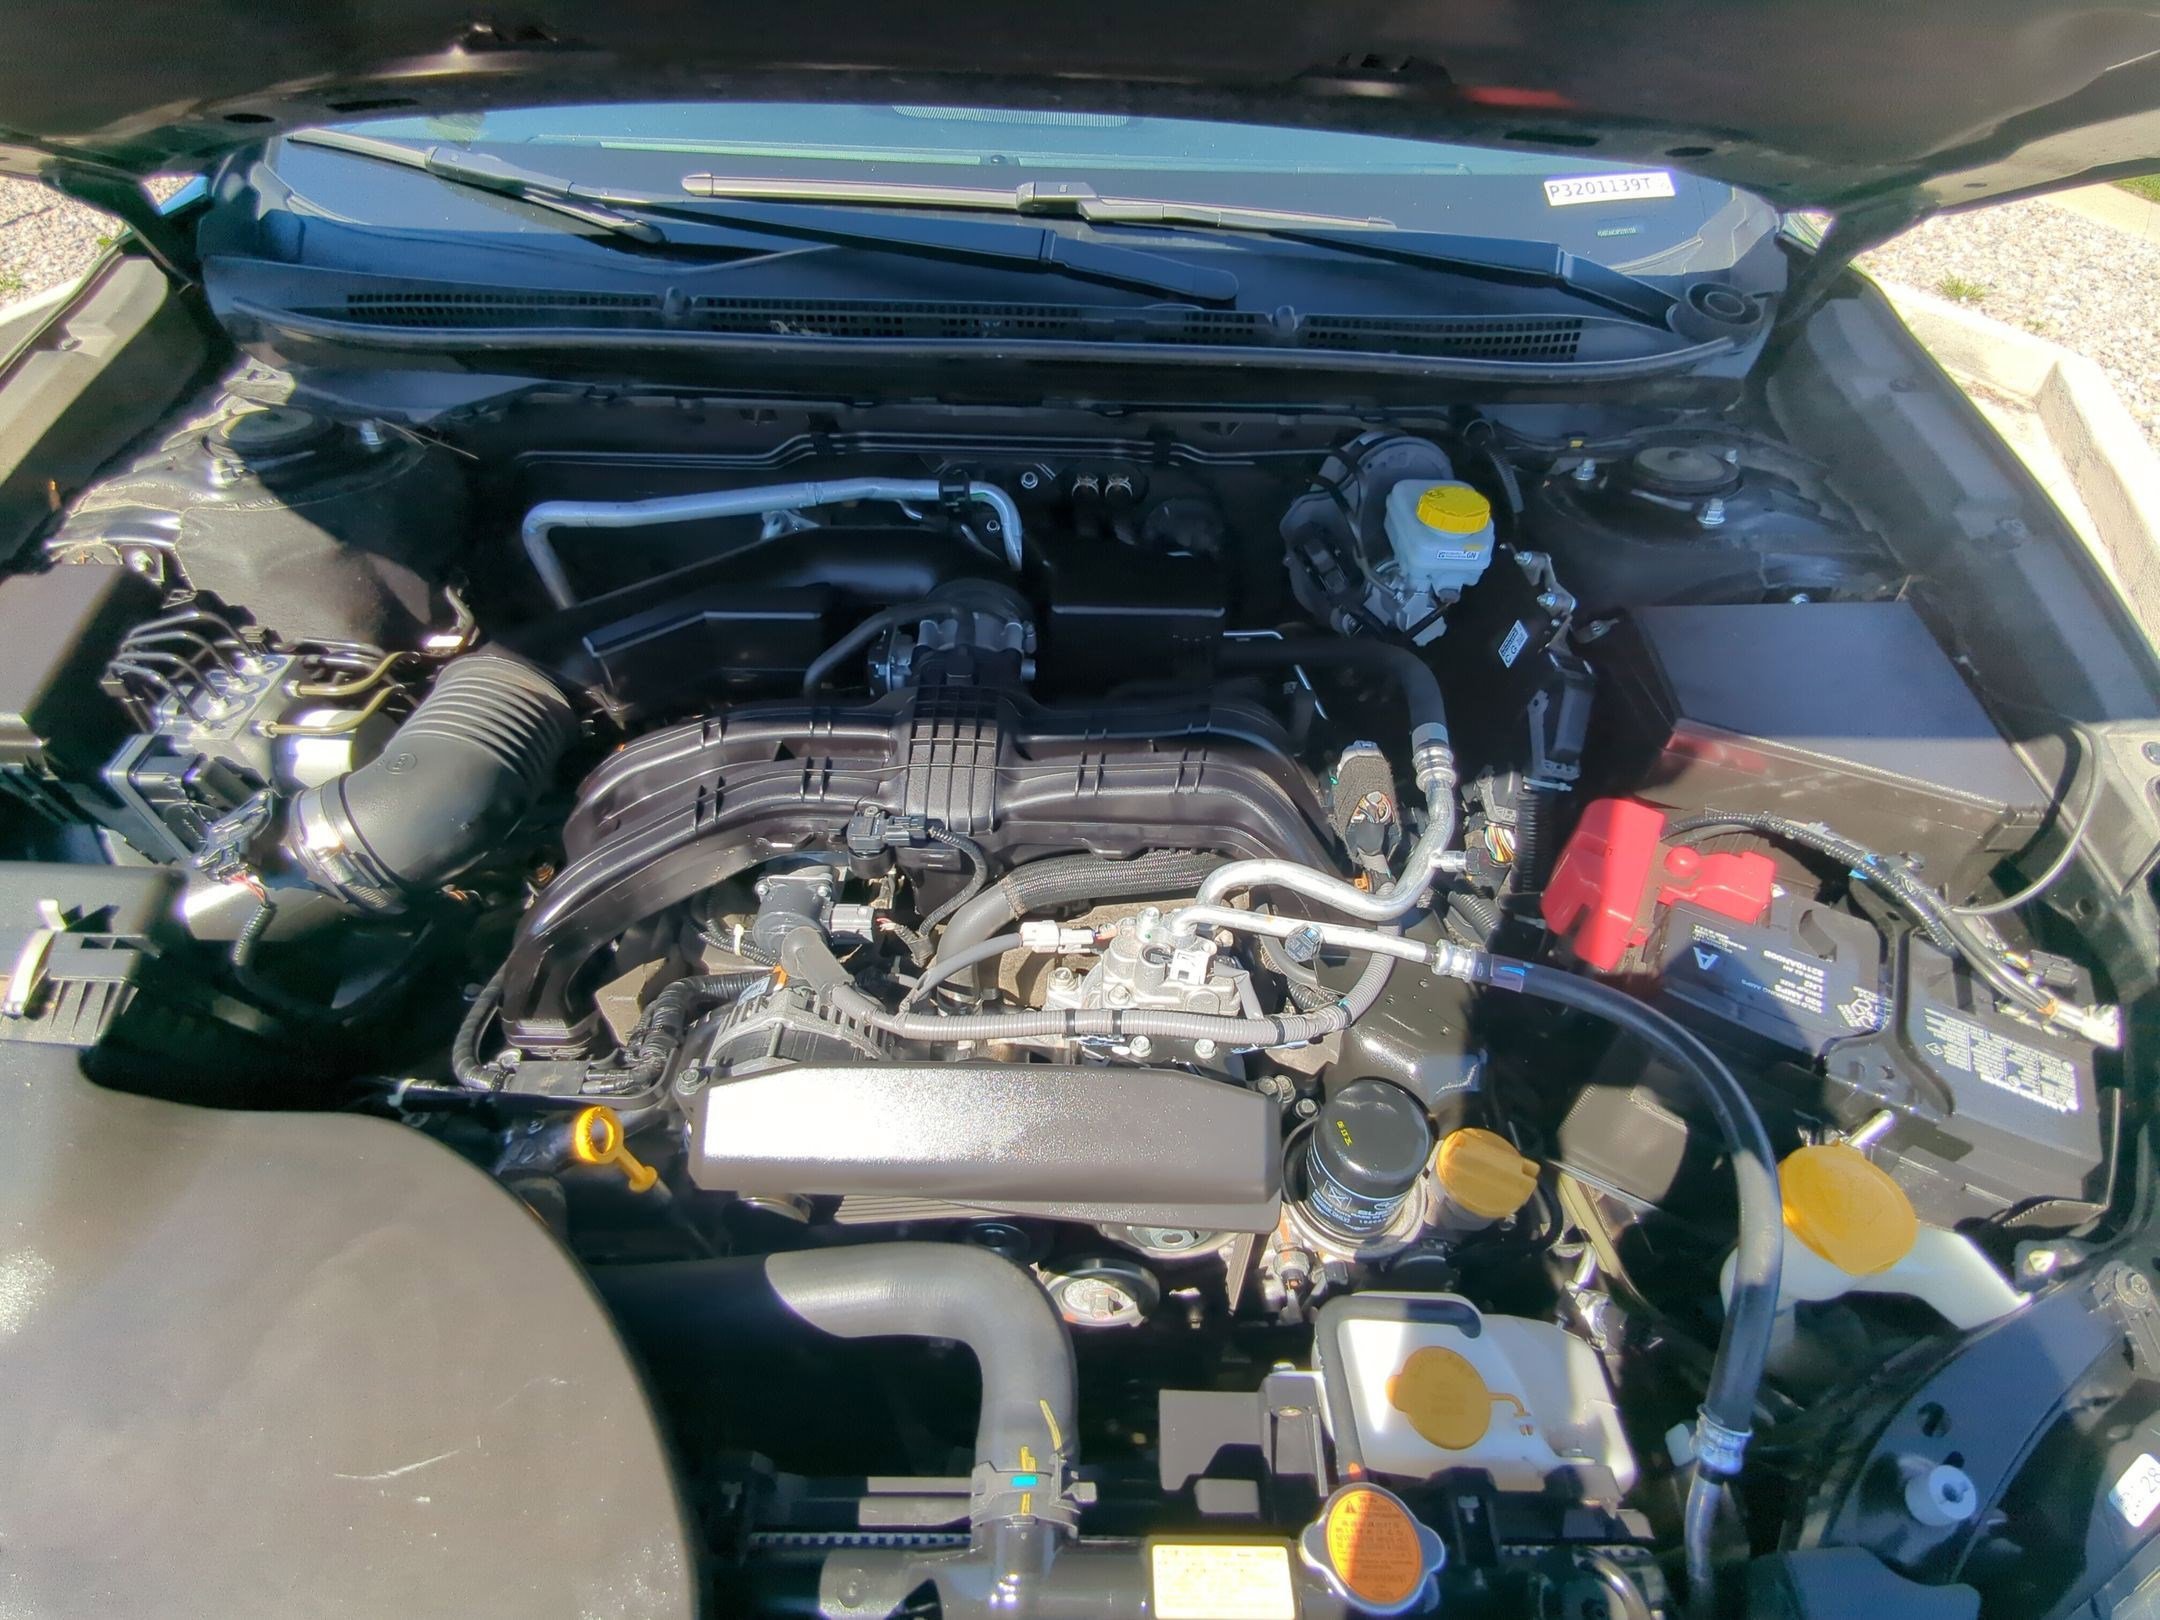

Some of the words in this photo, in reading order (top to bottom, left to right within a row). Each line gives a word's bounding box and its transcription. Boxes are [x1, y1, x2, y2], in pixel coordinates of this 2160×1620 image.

[1549, 177, 1651, 198] P3201139T
[1693, 947, 1718, 970] A
[1741, 978, 1762, 990] AMPS
[1779, 978, 1796, 988] SIZE
[1762, 987, 1801, 1006] CRANKING
[1774, 984, 1804, 1000] AMPS
[1796, 985, 1823, 999] GROUP
[1800, 1001, 1822, 1014] COLD
